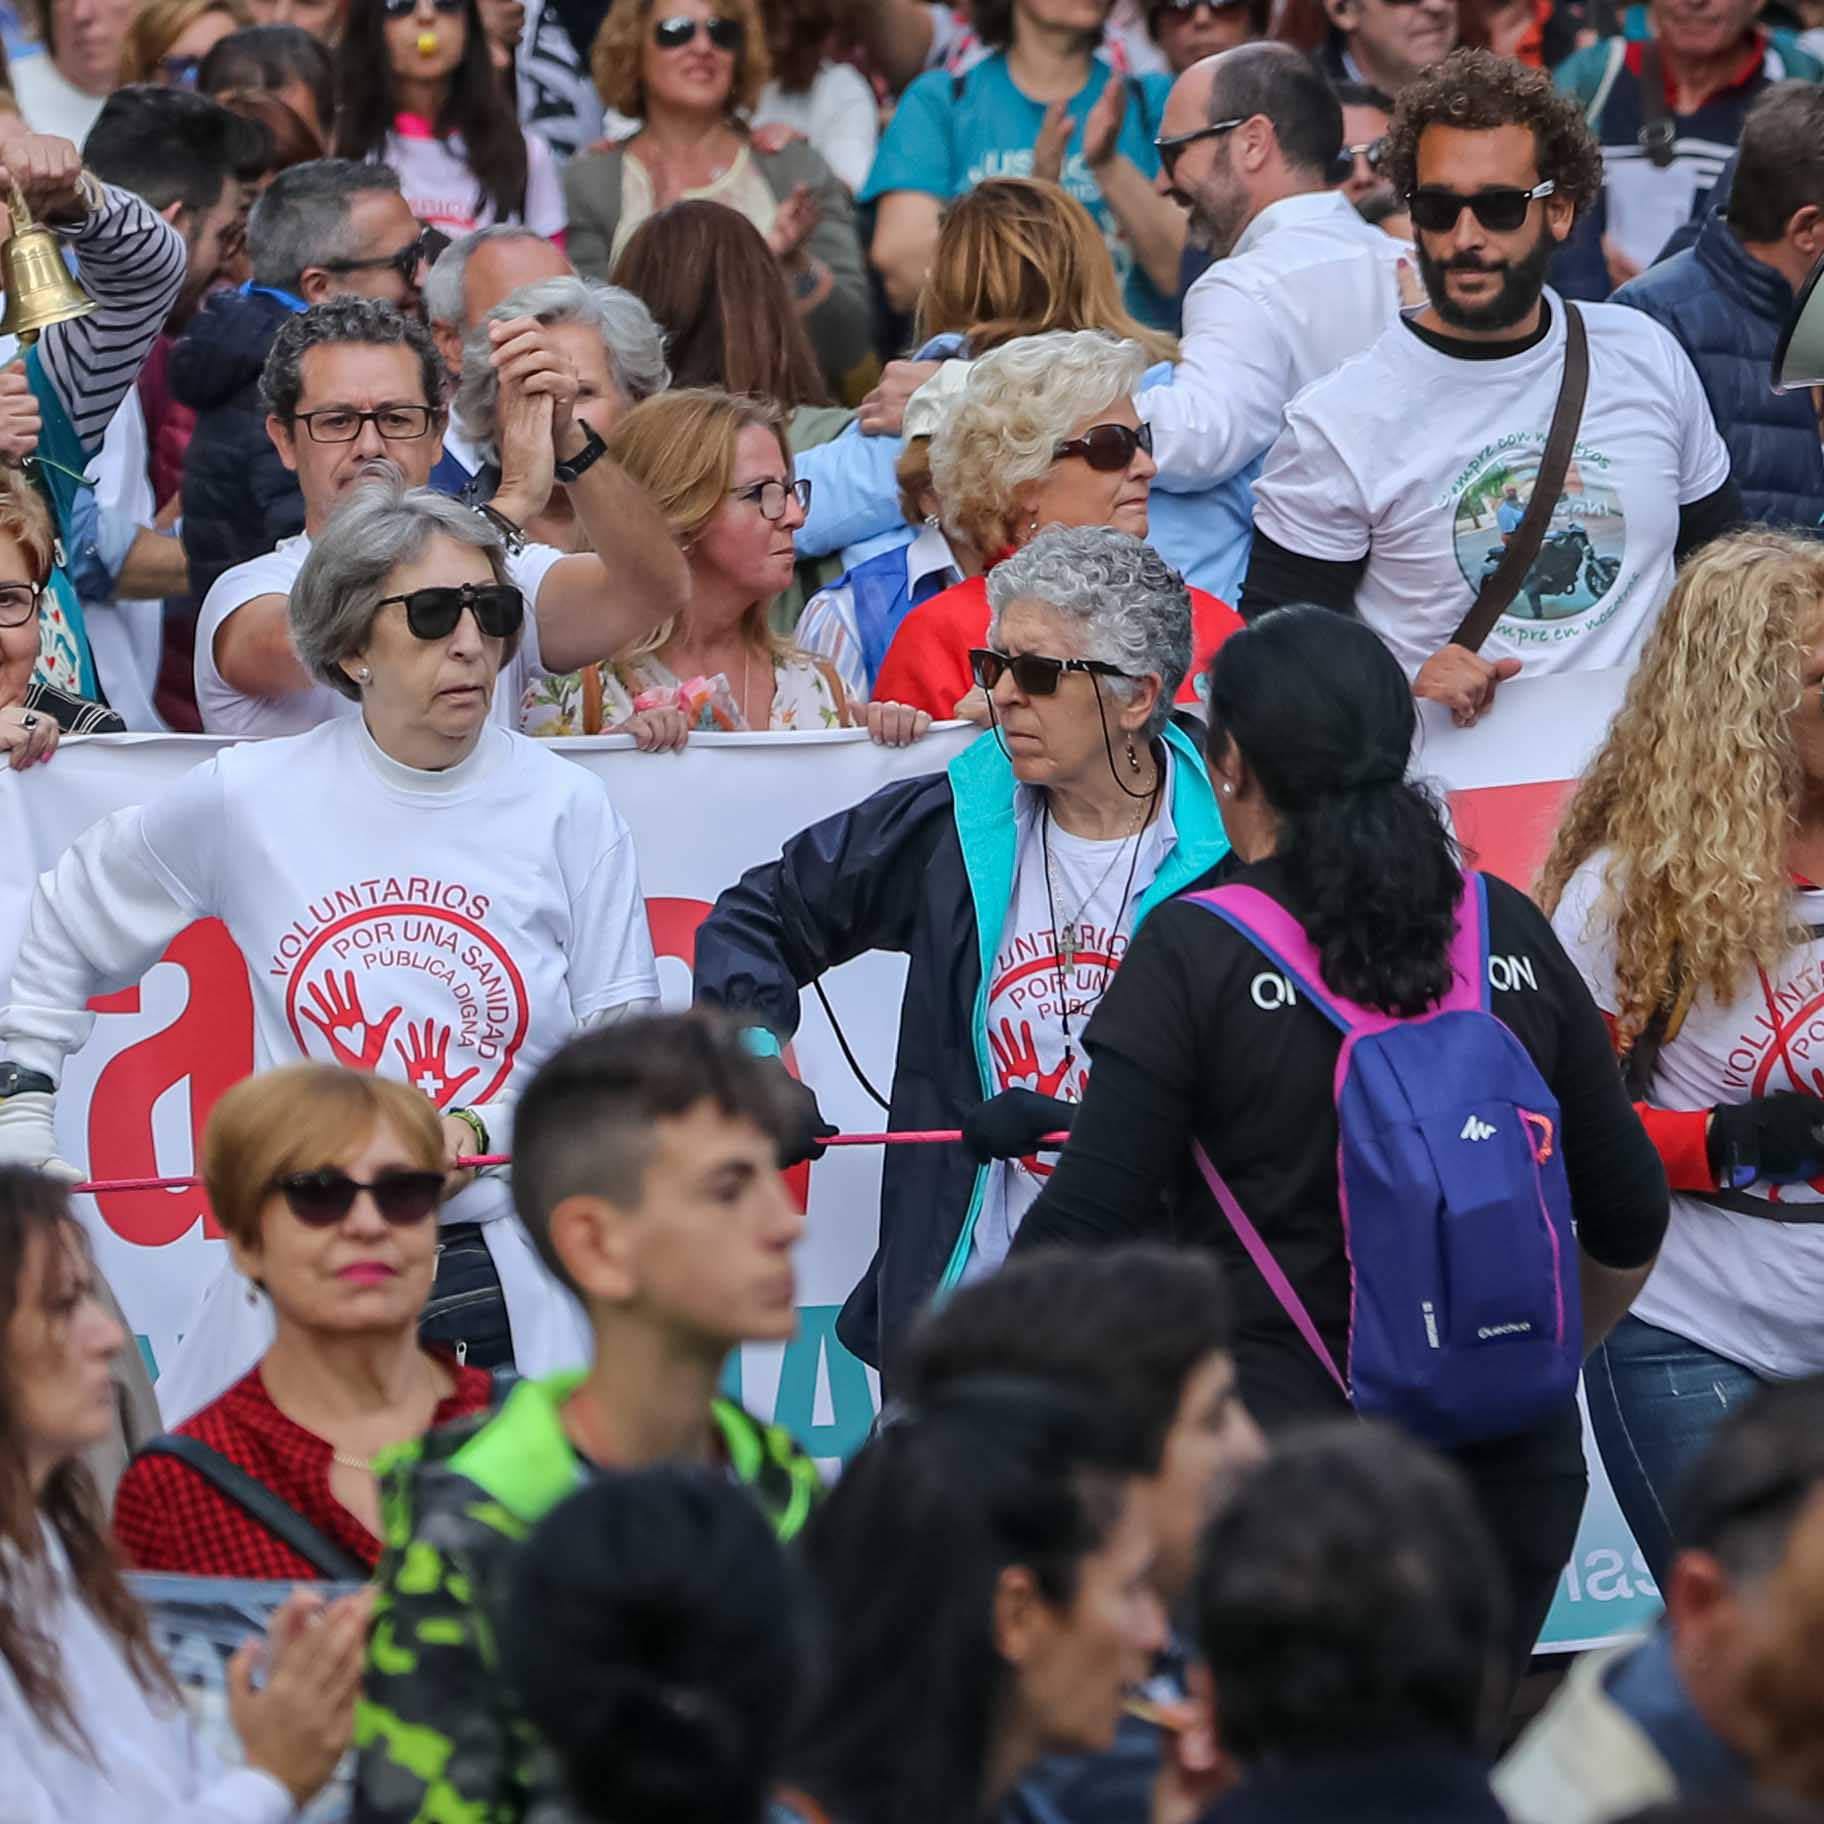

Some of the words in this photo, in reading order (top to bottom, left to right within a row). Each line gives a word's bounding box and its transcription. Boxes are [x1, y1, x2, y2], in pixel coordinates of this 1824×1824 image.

[270, 877, 491, 977] VOLUNTARIOS
[332, 922, 395, 960] POR
[403, 920, 460, 954] UNA
[461, 945, 510, 1061] SANIDAD
[362, 947, 456, 987] PÚBLICA
[452, 982, 479, 1049] DIGNA
[1008, 972, 1069, 1010] POR
[1076, 969, 1110, 993] UN
